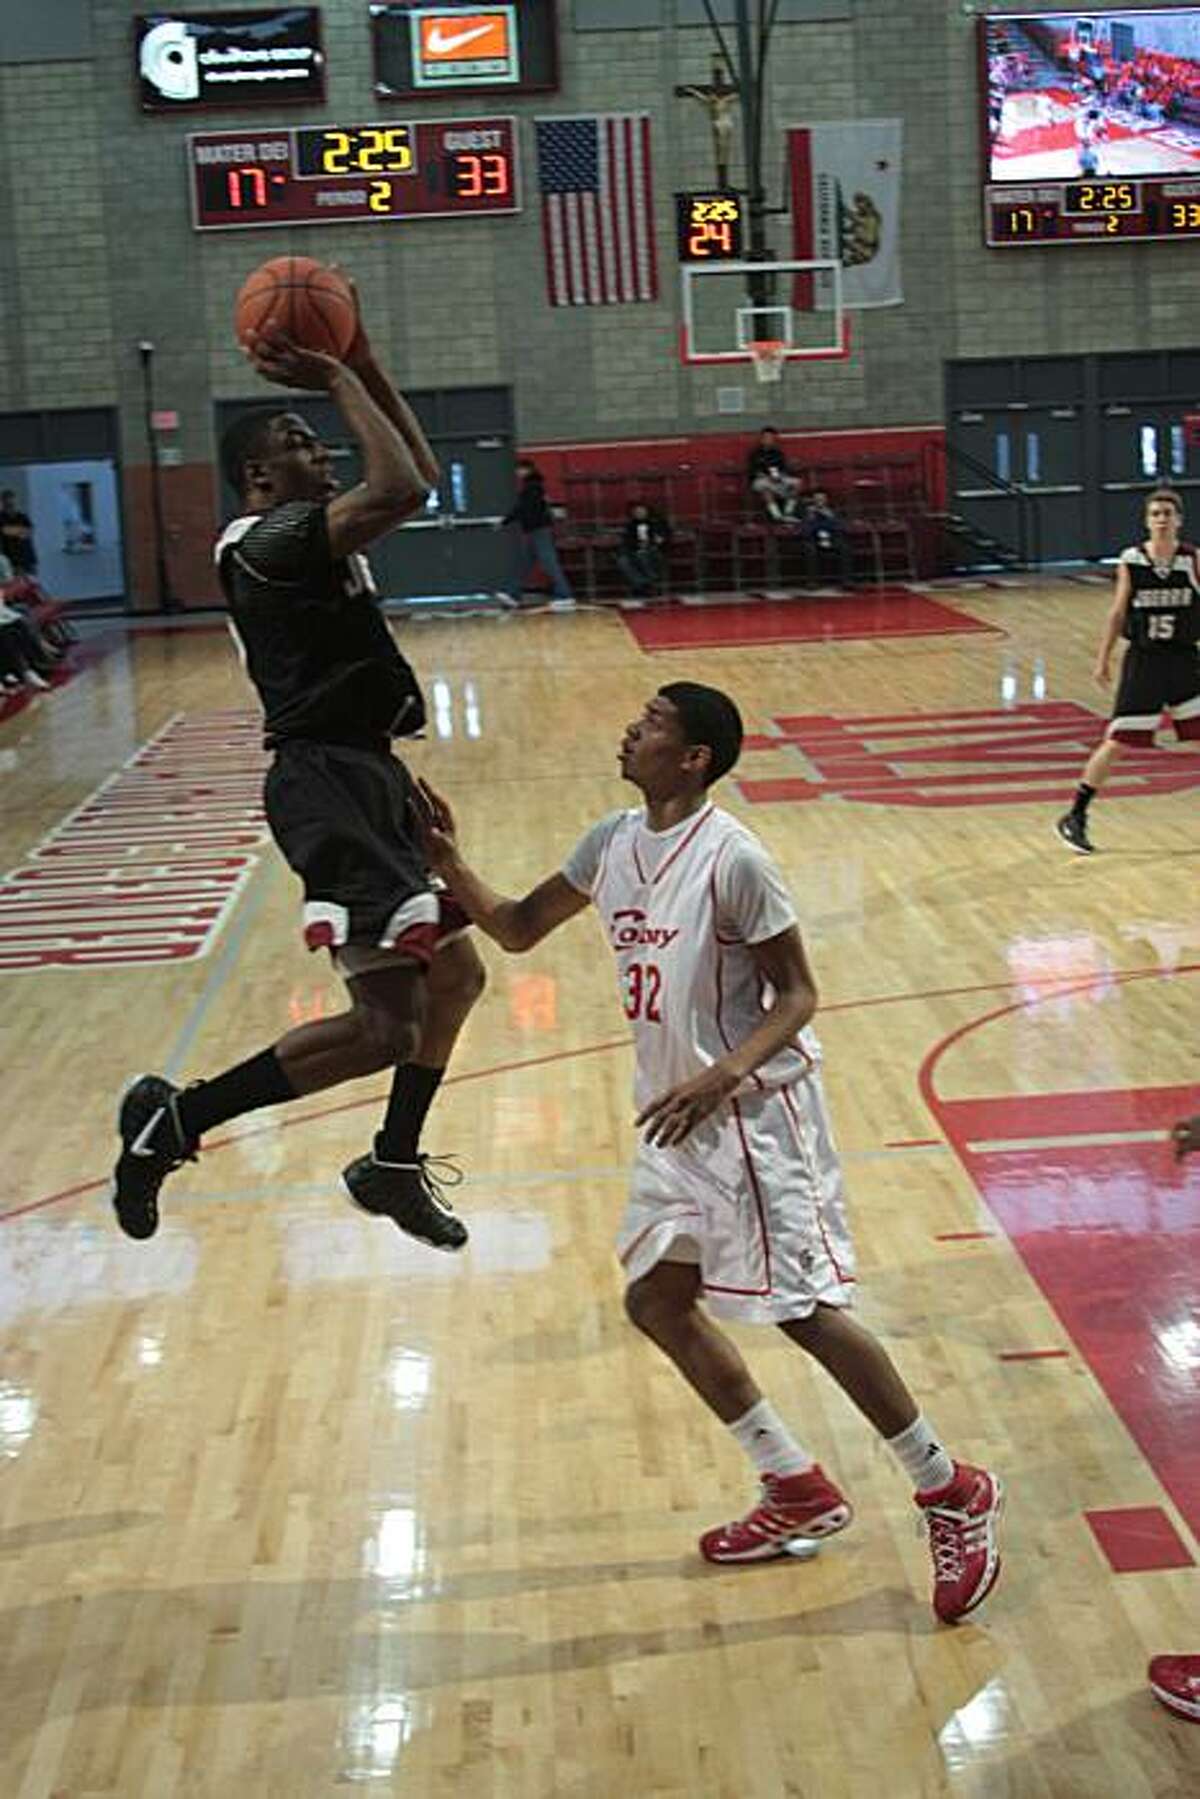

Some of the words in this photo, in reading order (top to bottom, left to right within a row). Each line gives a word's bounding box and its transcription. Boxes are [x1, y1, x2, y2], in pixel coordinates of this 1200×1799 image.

[323, 129, 412, 174] 2:25
[228, 167, 267, 207] 17
[456, 154, 508, 197] 33
[369, 181, 392, 212] 2
[1080, 184, 1133, 210] 2:25
[1010, 209, 1034, 232] 17
[690, 222, 732, 256] 24
[1147, 613, 1176, 640] 15
[624, 962, 662, 1025] 32
